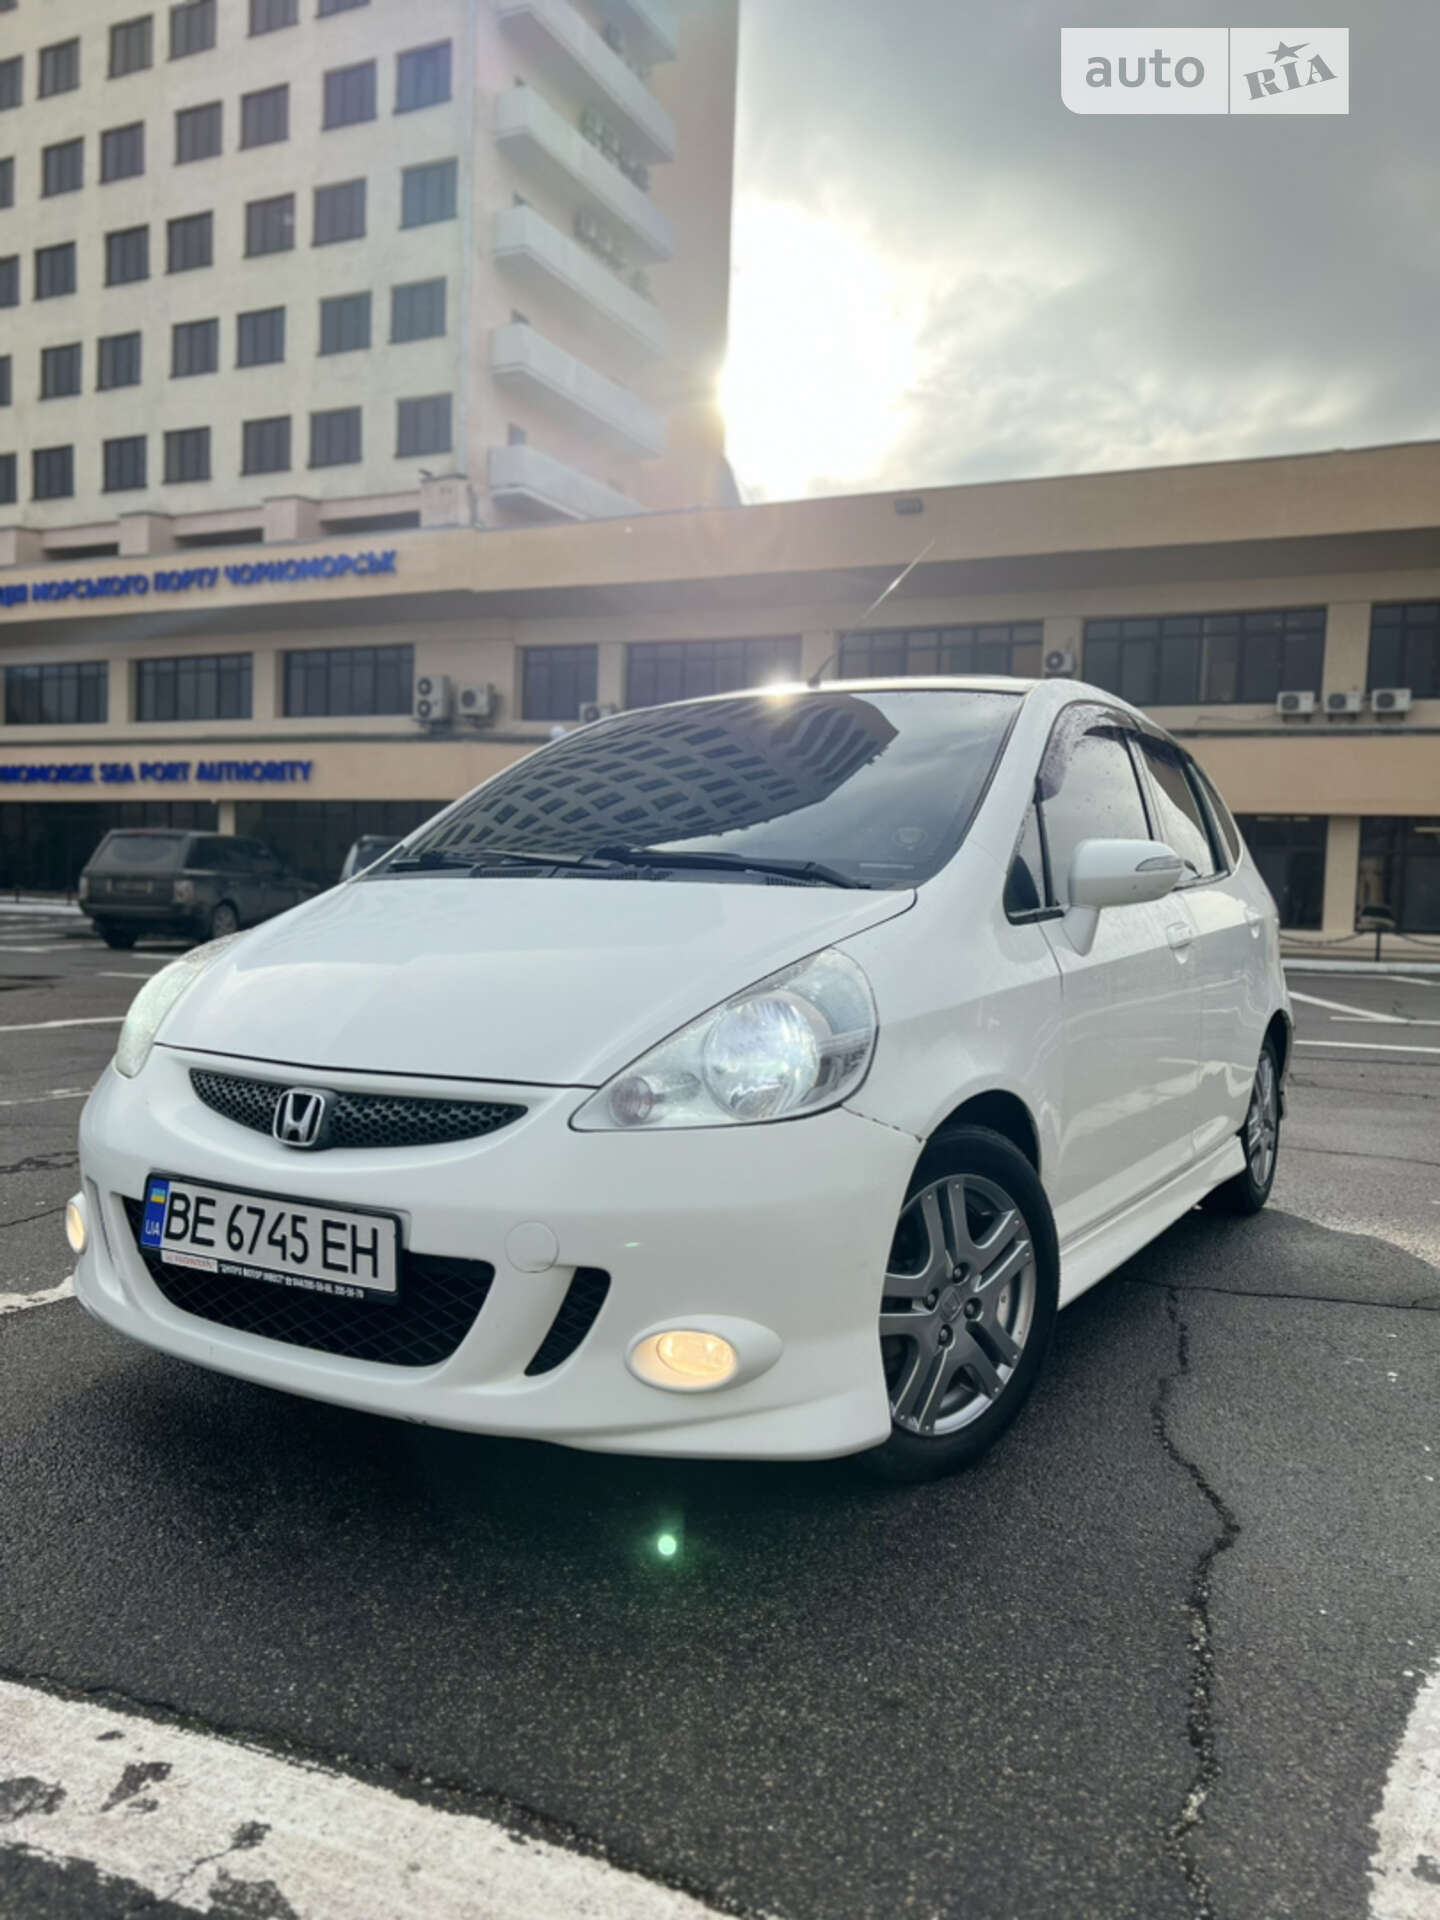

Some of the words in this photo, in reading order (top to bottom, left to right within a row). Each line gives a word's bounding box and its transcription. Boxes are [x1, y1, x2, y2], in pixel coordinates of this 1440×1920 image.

[154, 566, 219, 594] ПОРТУ
[224, 549, 398, 586] ЧОРНОМОРСЬК
[99, 762, 135, 783] SEA
[139, 761, 191, 783] PORT
[196, 759, 313, 783] AUTHORITY
[145, 1219, 161, 1236] UA
[164, 1191, 217, 1248] BE
[226, 1203, 310, 1265] 6745
[321, 1219, 379, 1279] EH
